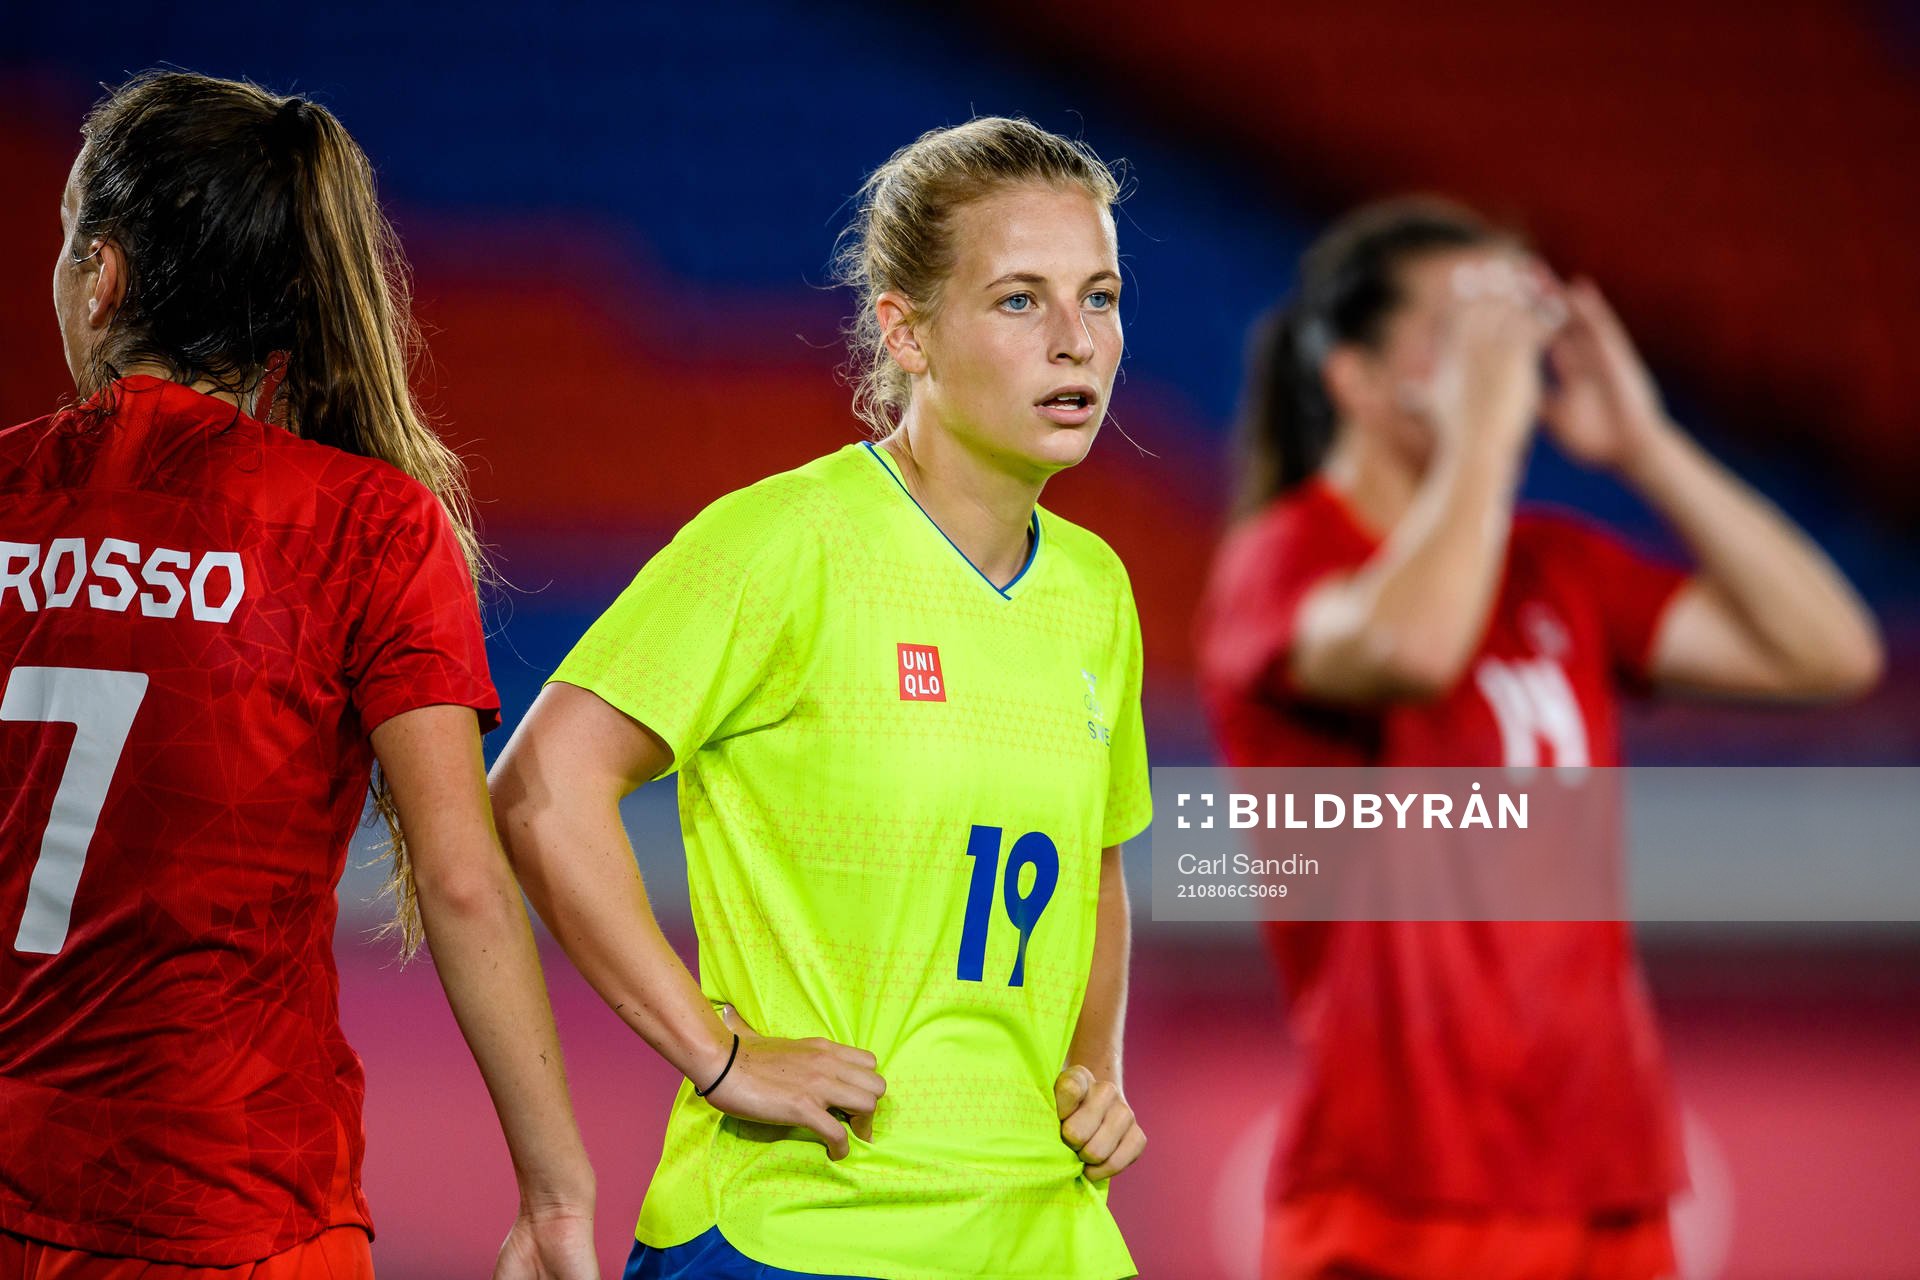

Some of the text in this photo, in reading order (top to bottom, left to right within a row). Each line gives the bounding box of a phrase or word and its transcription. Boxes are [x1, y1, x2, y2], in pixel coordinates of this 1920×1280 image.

[0, 538, 245, 623] ROSSO
[902, 650, 935, 671] UNI
[904, 674, 941, 697] QLO
[0, 666, 149, 954] 7
[956, 824, 1060, 987] 19
